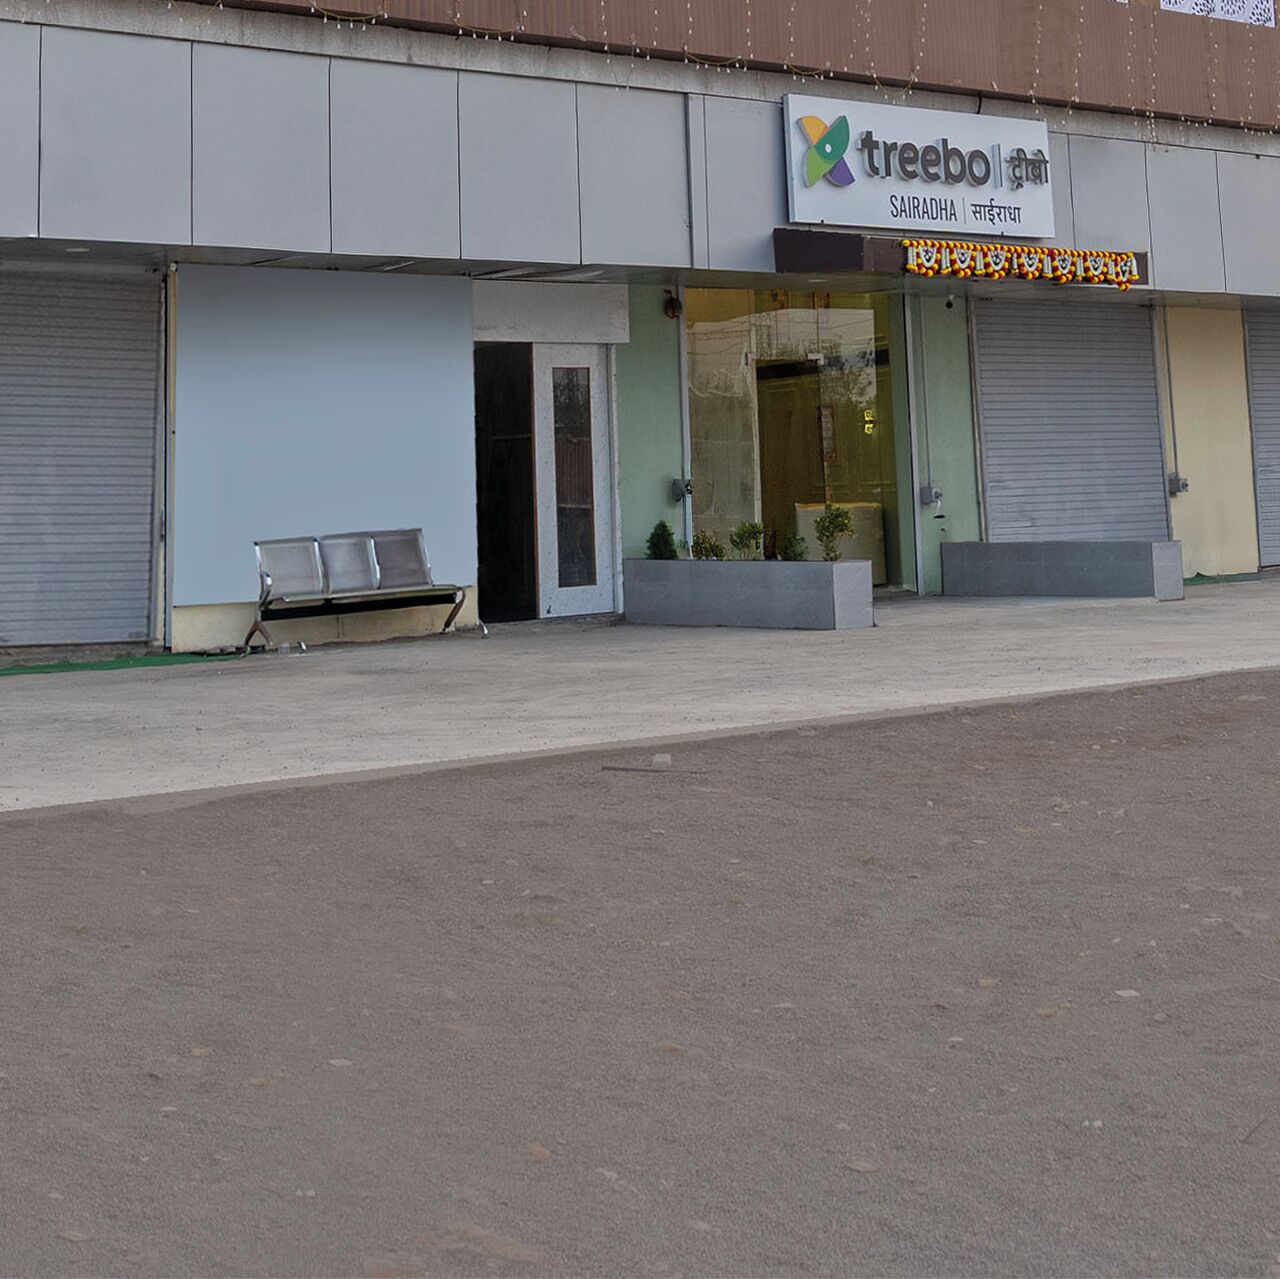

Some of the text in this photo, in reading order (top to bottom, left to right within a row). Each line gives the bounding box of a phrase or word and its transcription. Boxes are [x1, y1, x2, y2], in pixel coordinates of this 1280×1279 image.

[856, 130, 990, 187] treebo
[890, 194, 957, 222] SAIRADHA
[971, 198, 1021, 225] साईराधा
